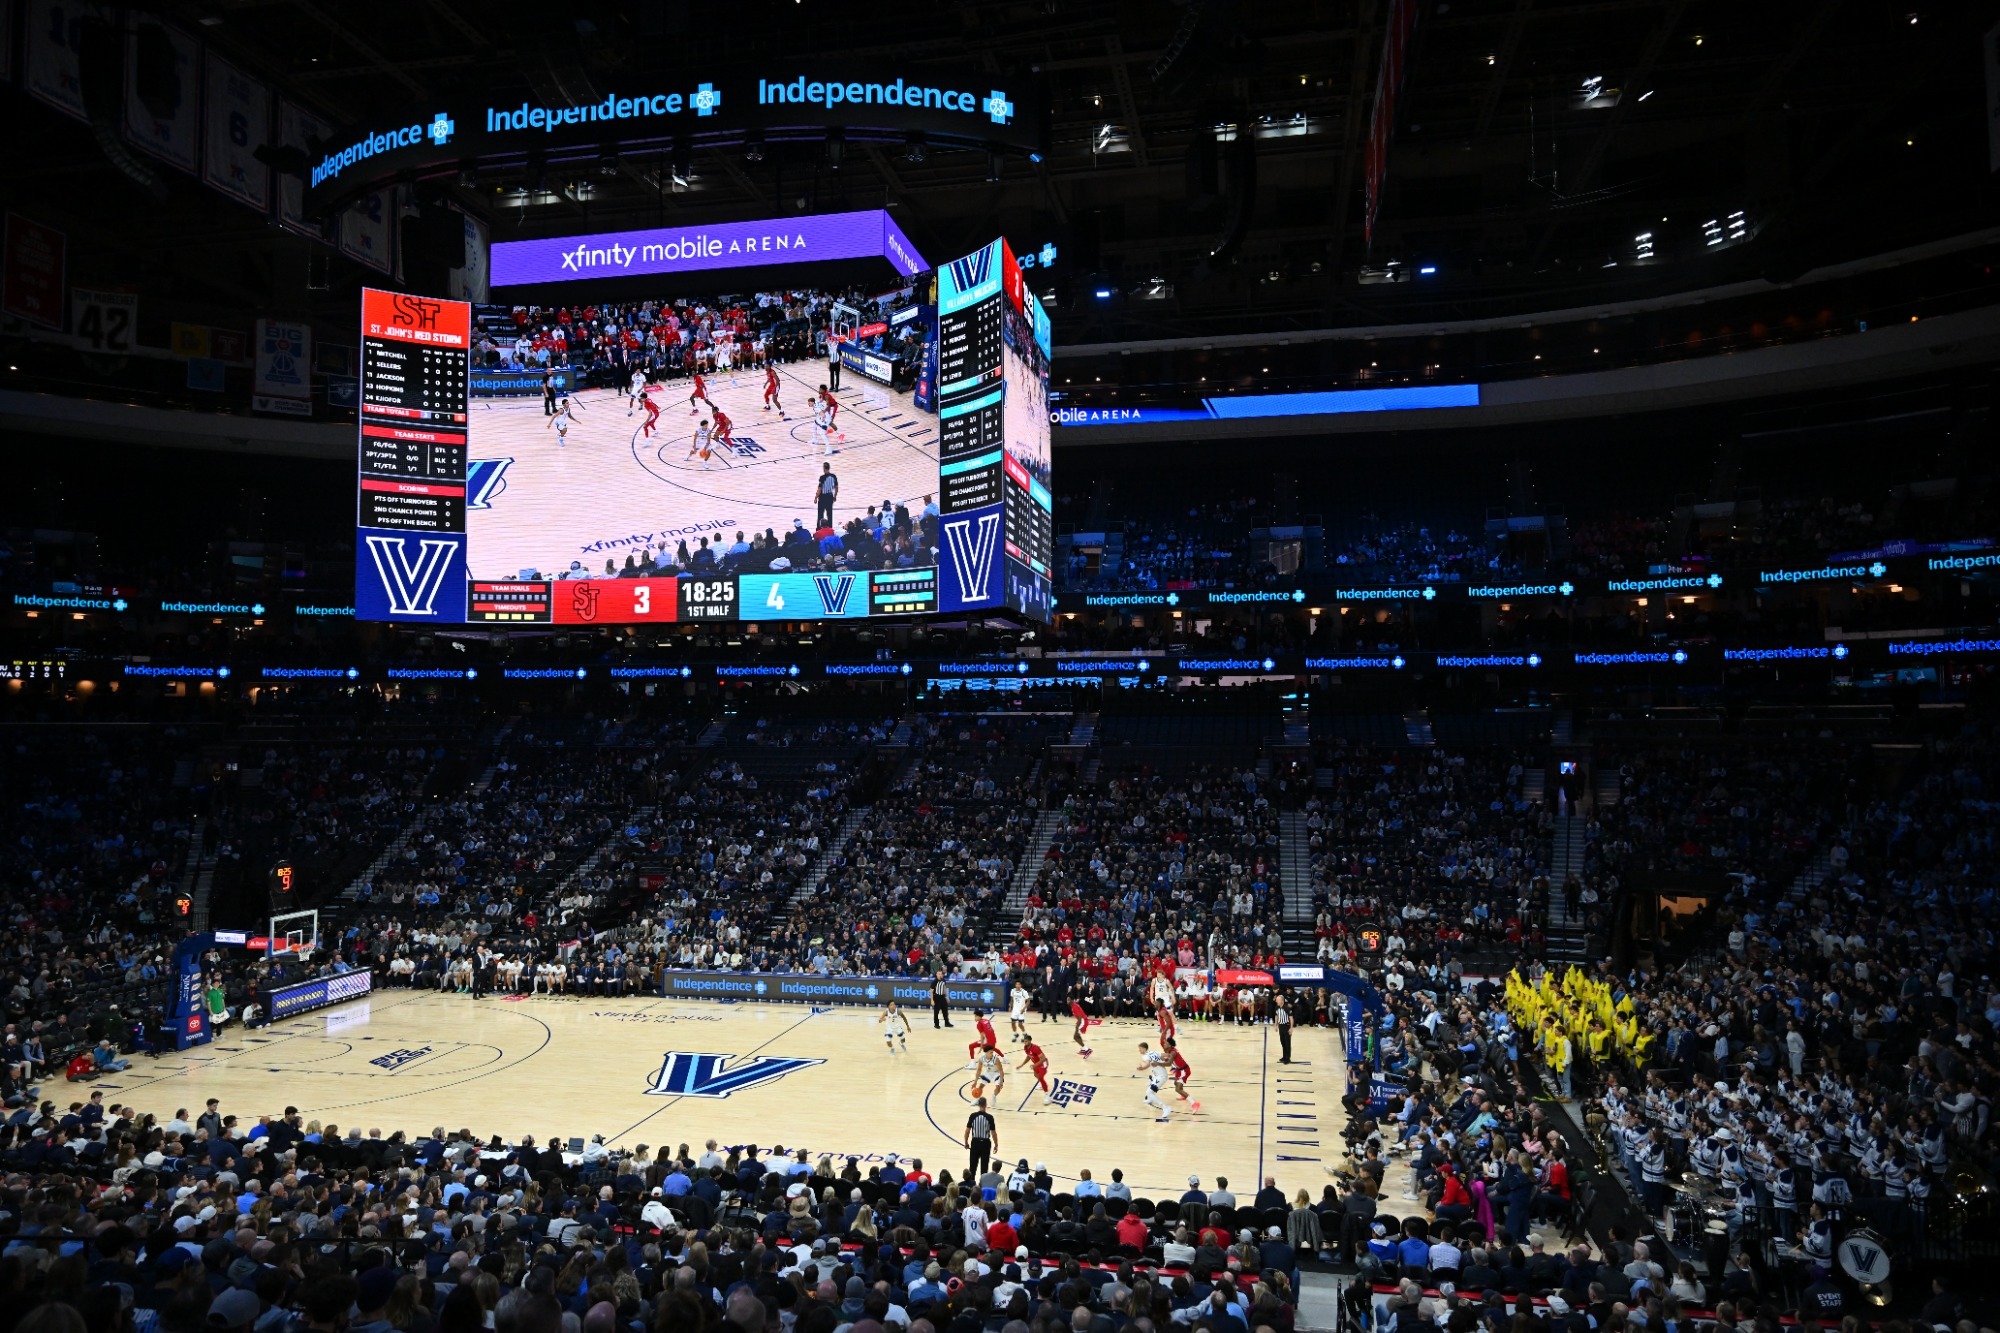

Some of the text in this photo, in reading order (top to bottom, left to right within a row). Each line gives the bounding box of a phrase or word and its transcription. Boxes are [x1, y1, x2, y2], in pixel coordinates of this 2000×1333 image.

[759, 75, 975, 113] Independence
[487, 93, 682, 132] Independence
[230, 111, 247, 147] 6
[311, 125, 422, 188] Independence
[561, 235, 806, 272] xfinity mobile ARENA
[79, 305, 129, 349] 42
[384, 326, 413, 339] JOHN'S
[414, 331, 431, 340] RED
[432, 333, 463, 345] STORM
[1050, 402, 1140, 423] obile ARENA
[415, 432, 435, 440] STATS
[400, 498, 437, 506] TURNOVERS
[388, 507, 413, 515] CHANCE
[580, 533, 654, 554] xfinity
[944, 513, 999, 602] V
[366, 536, 459, 614] V
[1760, 566, 1866, 583] Independence
[1468, 583, 1557, 598] Independence
[1608, 576, 1703, 592] Independence
[682, 581, 734, 602] 18:25
[766, 582, 785, 610] 4
[813, 574, 856, 615] V
[1208, 590, 1290, 604] Independence
[1336, 587, 1421, 601] Independence
[14, 594, 111, 609] Independence
[634, 586, 650, 614] 3
[1086, 593, 1165, 607] Independence
[161, 601, 249, 615] Independence
[687, 605, 730, 617] 1ST HALF
[1436, 654, 1525, 668] Independence
[1574, 651, 1670, 665] Independence
[1724, 646, 1830, 662] Independence
[825, 663, 899, 676] Independence
[939, 661, 1015, 674] Independence
[1057, 660, 1136, 673] Independence
[1178, 658, 1260, 671] Independence
[1305, 656, 1390, 670] Independence
[124, 665, 215, 678] Independence
[261, 667, 345, 679] Independence
[387, 667, 464, 680] Independence
[503, 668, 575, 680] Independence
[610, 667, 679, 678] Independence
[716, 665, 787, 677] Independence
[282, 876, 290, 890] 9
[673, 977, 753, 992] Independence
[781, 983, 863, 997] Independence
[894, 986, 978, 1001] Indepence
[1052, 1080, 1078, 1109] EAST
[1073, 1084, 1097, 1104] BIG
[970, 1220, 977, 1231] 0
[1846, 1240, 1881, 1275] V
[1817, 1292, 1842, 1300] EVENT
